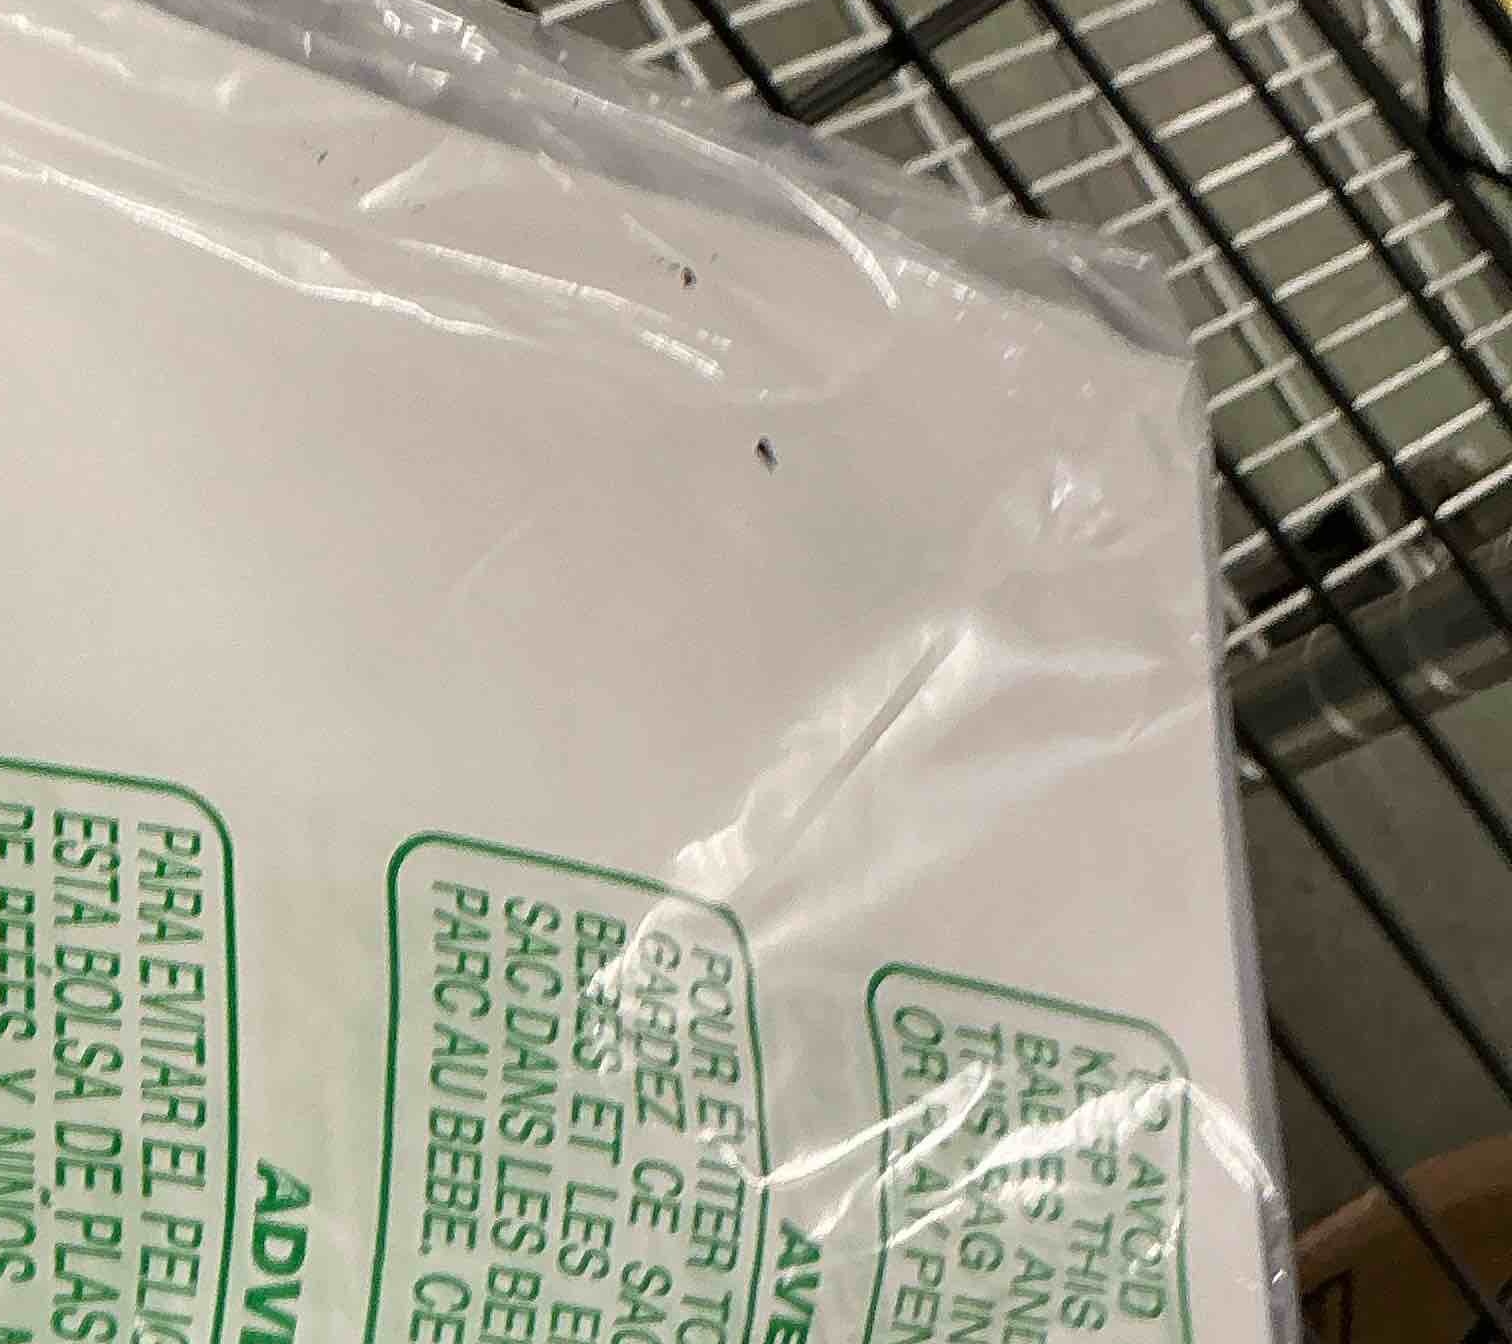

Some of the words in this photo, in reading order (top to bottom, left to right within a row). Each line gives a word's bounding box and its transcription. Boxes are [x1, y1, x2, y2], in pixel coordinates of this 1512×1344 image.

[51, 809, 120, 928] ESTA
[136, 821, 203, 946] PARA
[429, 880, 489, 1020] PARC
[502, 897, 560, 1001] SAC
[51, 944, 121, 1102] BOLSA
[137, 956, 206, 1131] EVITAR
[428, 1022, 488, 1100] AU
[634, 932, 686, 1133] GARDEZ
[688, 946, 742, 1086] POUR
[893, 1006, 947, 1083] OR
[498, 1006, 558, 1146] DANS
[568, 1093, 623, 1166] ET
[51, 1121, 121, 1195] DE
[139, 1135, 205, 1198] EL
[420, 1109, 484, 1255] BEBE.
[488, 1157, 551, 1254] LES
[627, 1158, 684, 1234] CE
[557, 1181, 617, 1280] LES
[1058, 1213, 1112, 1333] THIS
